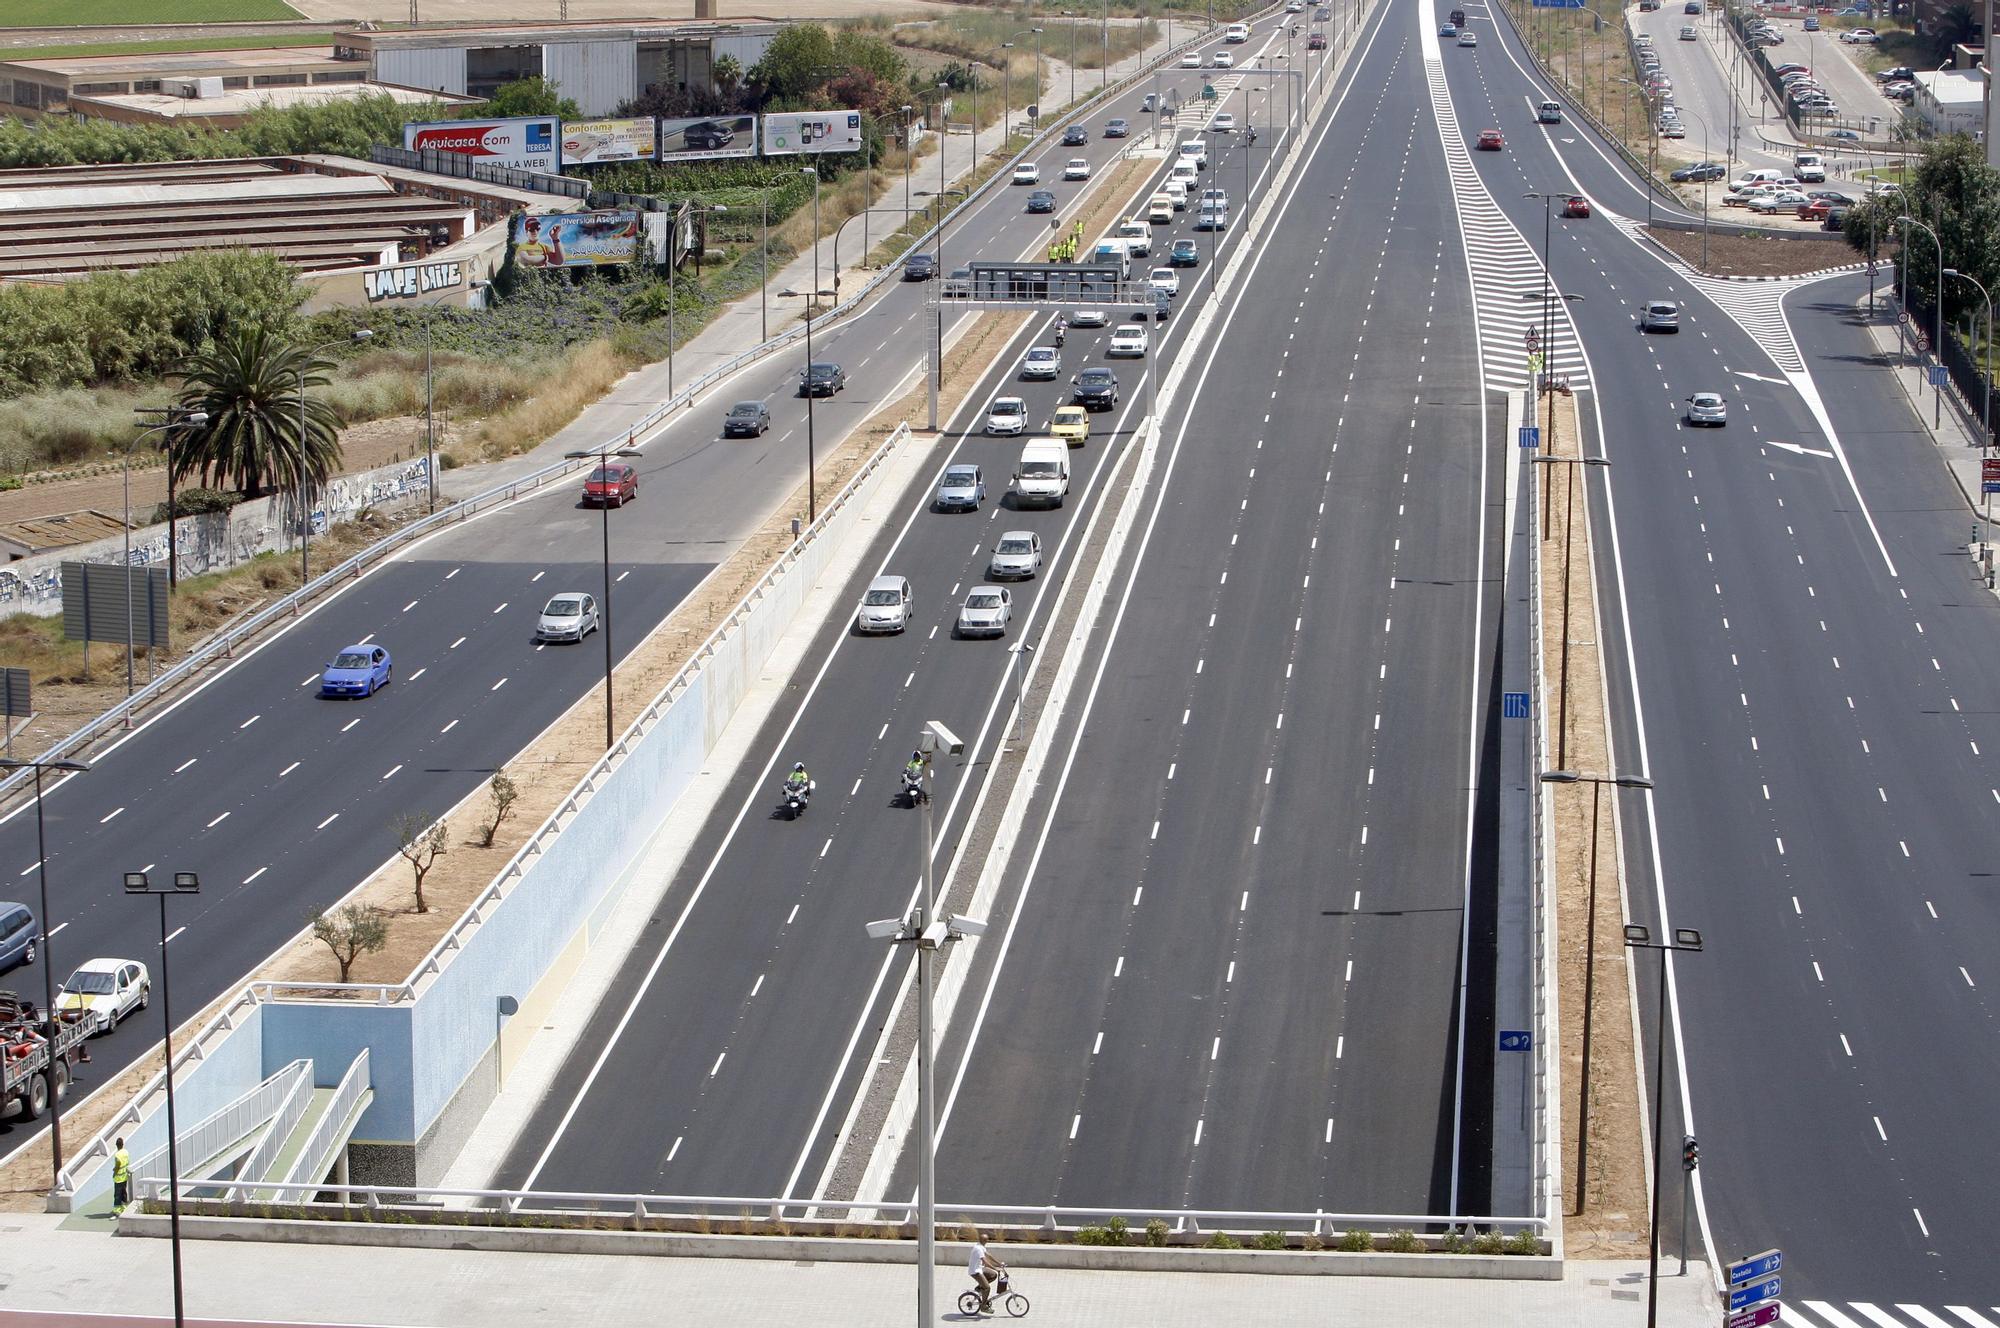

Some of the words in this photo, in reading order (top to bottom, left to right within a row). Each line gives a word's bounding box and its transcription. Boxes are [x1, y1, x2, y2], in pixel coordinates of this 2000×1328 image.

[563, 123, 613, 134] Conforama
[526, 143, 551, 152] TERESA
[508, 160, 521, 169] LA
